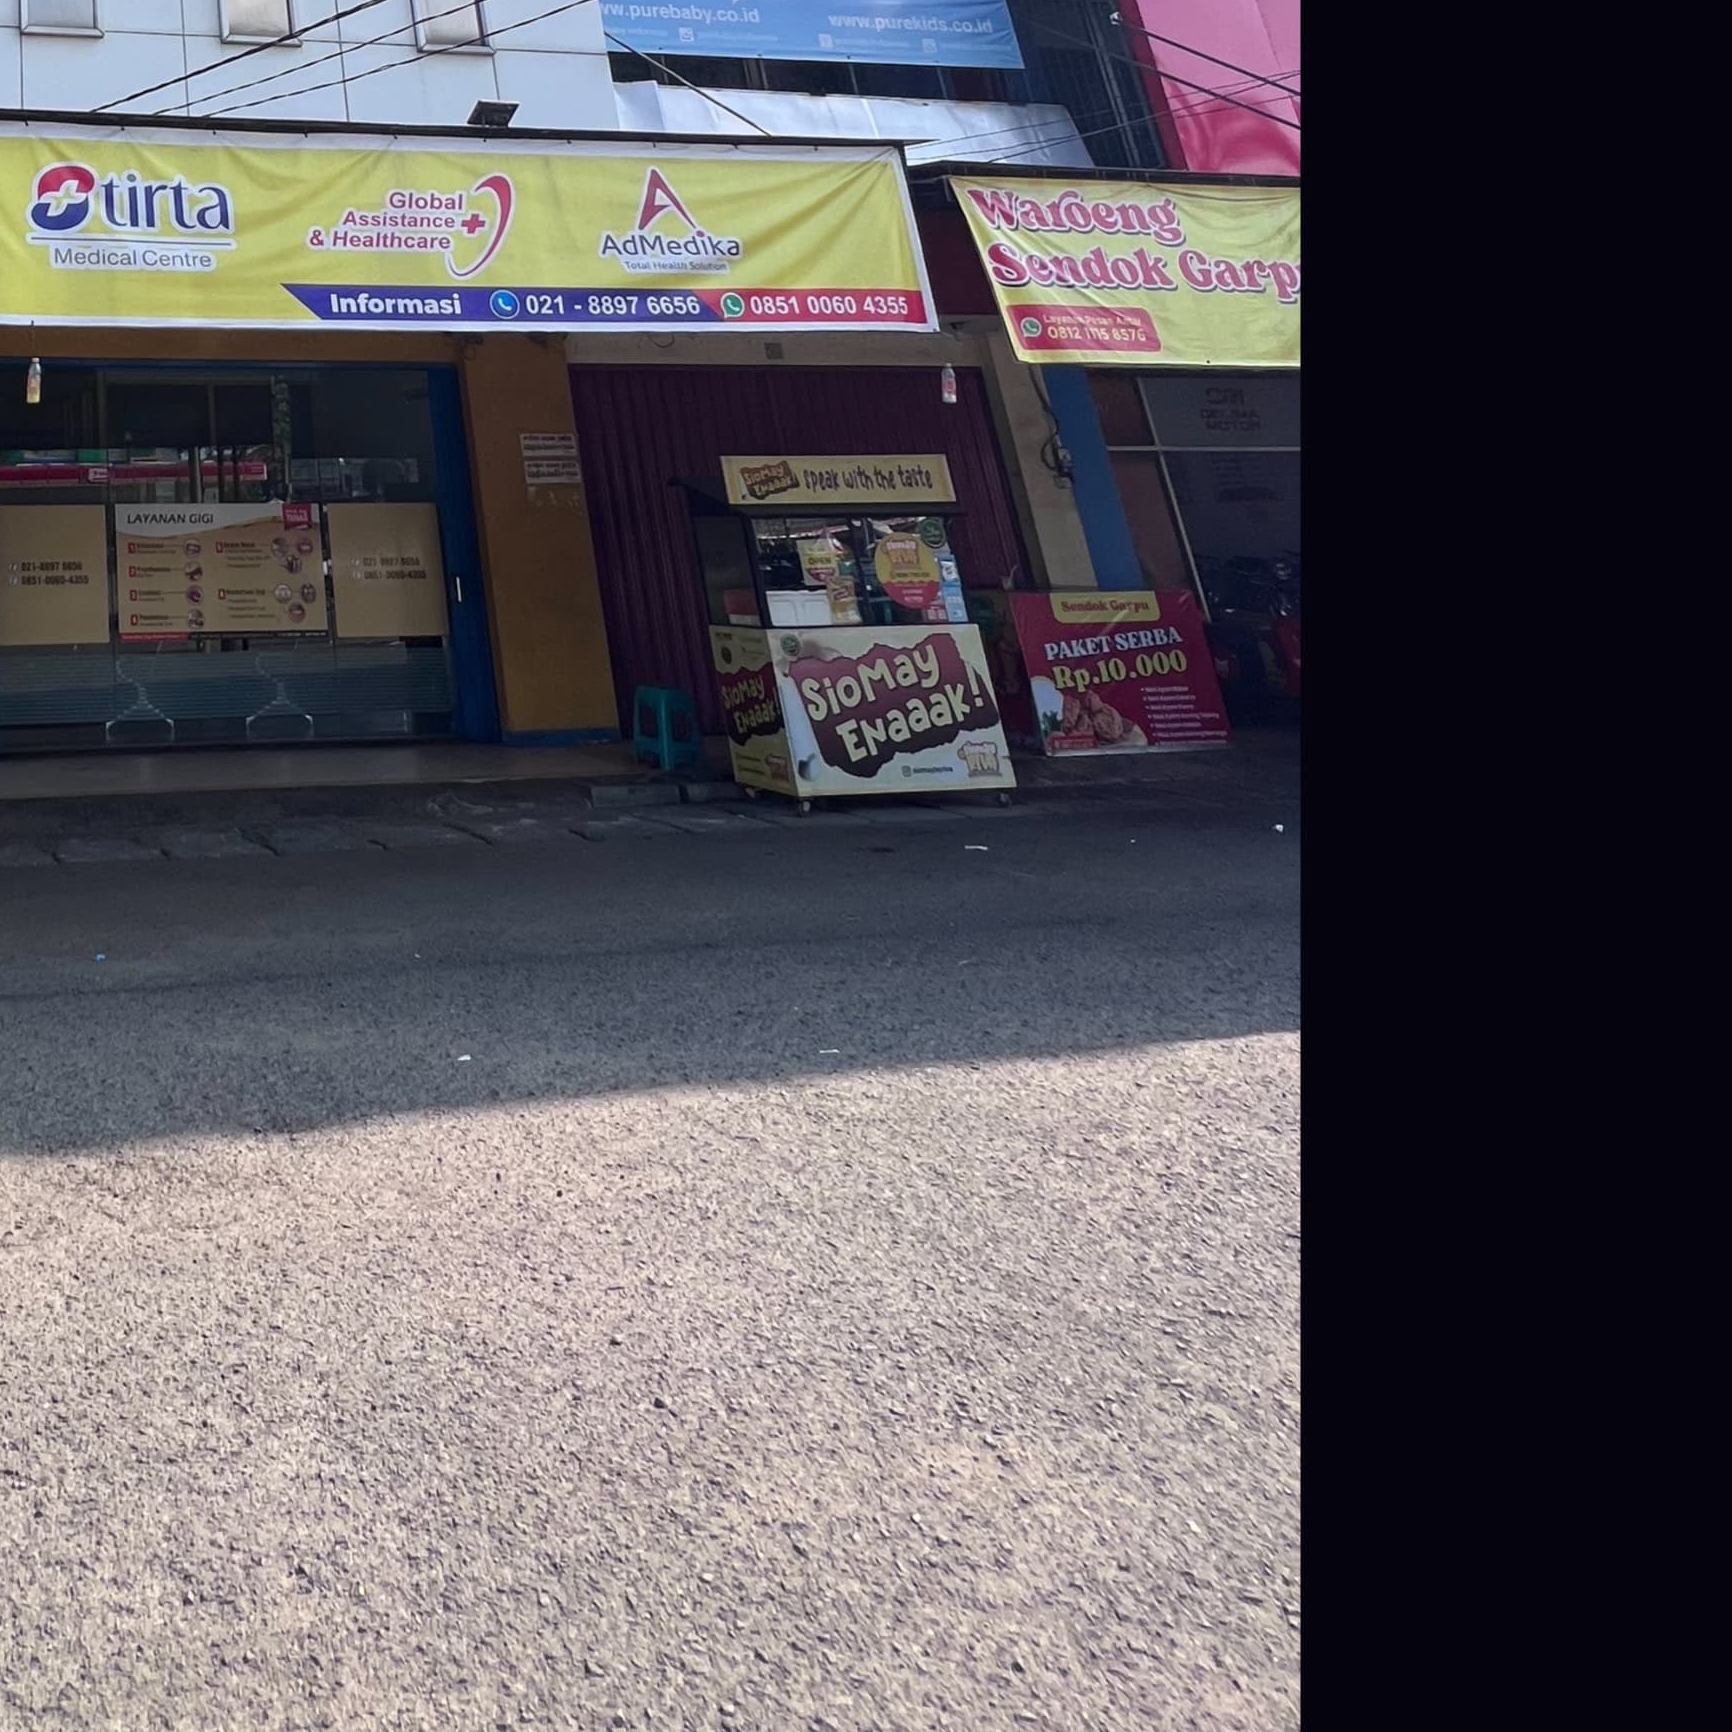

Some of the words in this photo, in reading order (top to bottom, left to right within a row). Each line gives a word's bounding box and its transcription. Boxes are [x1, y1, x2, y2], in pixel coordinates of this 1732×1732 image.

[101, 172, 233, 231] tirta
[389, 191, 464, 211] Global
[342, 211, 456, 229] Assistance
[967, 190, 1186, 246] Waroeng
[309, 229, 325, 247] &
[332, 230, 452, 250] Healthcare
[601, 232, 741, 257] AdMedika
[53, 246, 137, 266] Medical
[141, 248, 212, 268] Centre
[986, 241, 1177, 291] Sendok
[1177, 249, 1301, 302] Garp
[330, 291, 462, 315] Informasi
[525, 293, 565, 316] 021
[587, 293, 639, 316] 8897
[646, 293, 700, 316] 6656
[749, 293, 800, 316] 0851
[806, 293, 856, 316] 0060
[862, 293, 909, 316] 4355
[1047, 326, 1083, 340] 0812
[1112, 328, 1147, 342] 8576
[804, 468, 839, 492] speak
[842, 465, 874, 491] with
[873, 466, 896, 490] the
[898, 464, 934, 489] taste
[127, 513, 185, 524] LAYANAN
[189, 513, 214, 524] GIGI
[1061, 599, 1110, 613] Sendok
[1043, 634, 1112, 661] PAKET
[1114, 625, 1184, 652] SERBA
[1050, 648, 1189, 693] Rp.10.000
